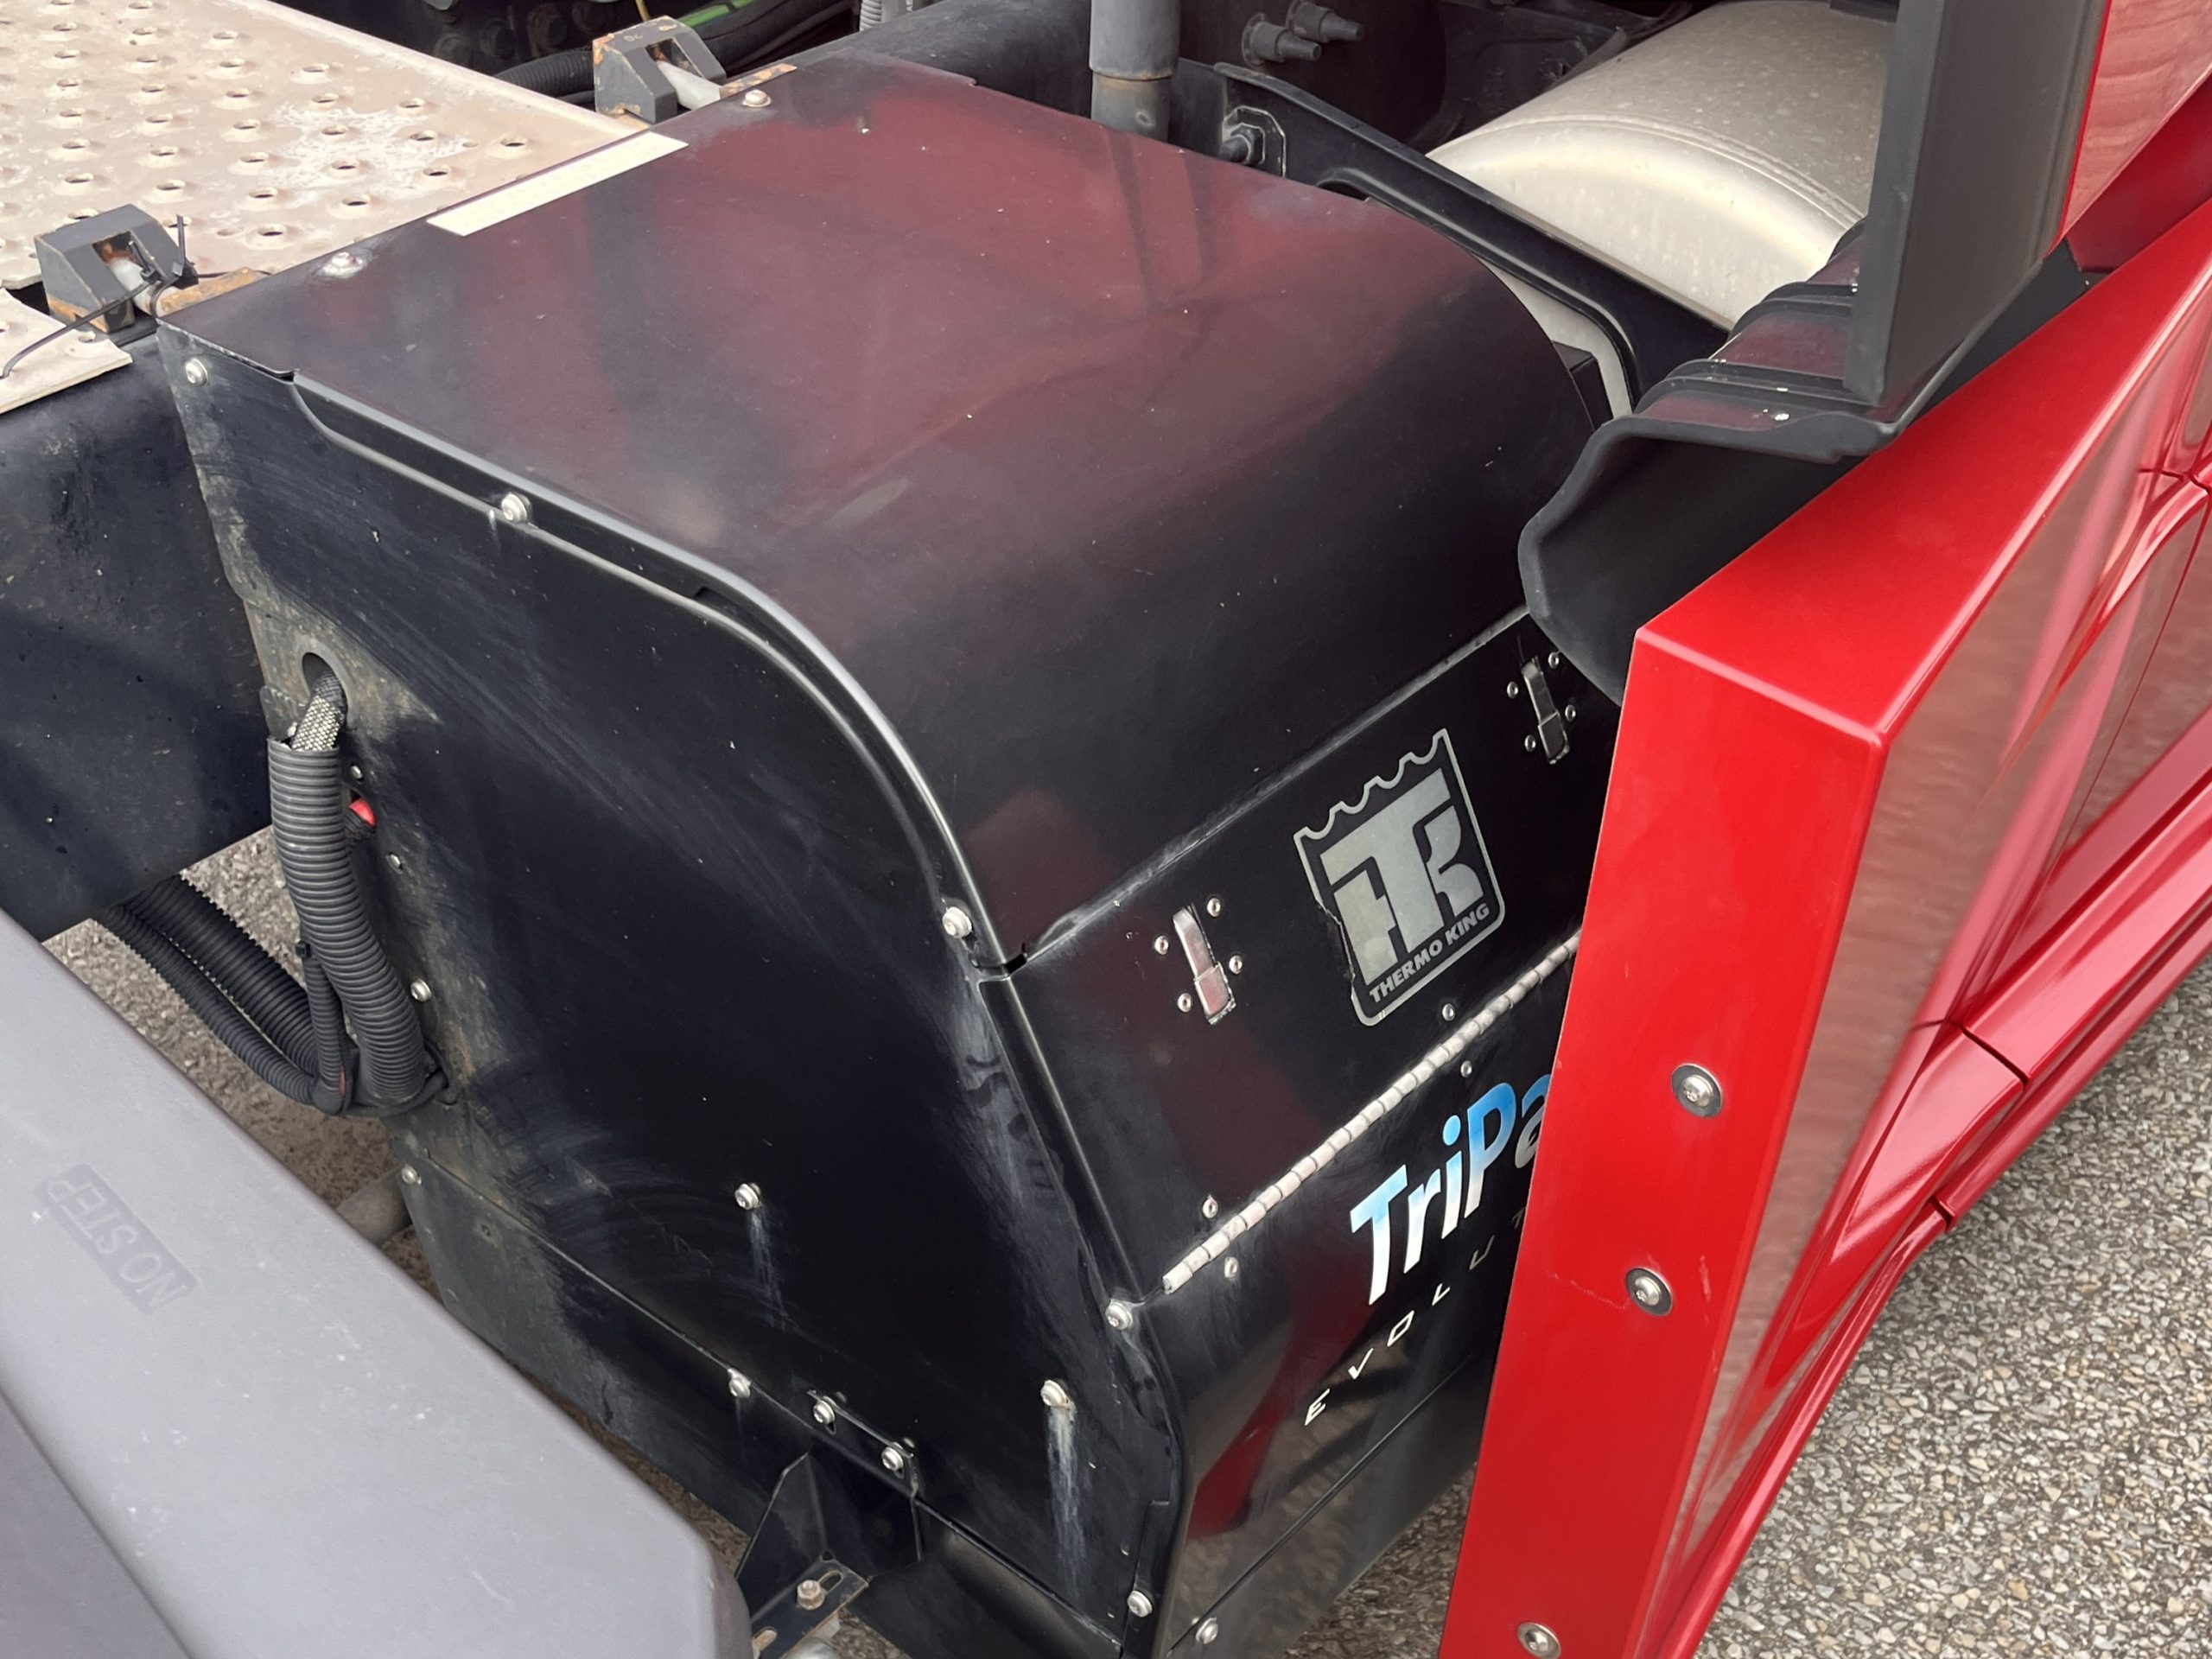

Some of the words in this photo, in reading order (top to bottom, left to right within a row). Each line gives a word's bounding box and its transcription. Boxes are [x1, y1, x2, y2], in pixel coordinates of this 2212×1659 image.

[1369, 938, 1444, 1003] THERMO
[1446, 903, 1491, 945] KING
[46, 1180, 138, 1254] STEP
[119, 1254, 188, 1307] NO
